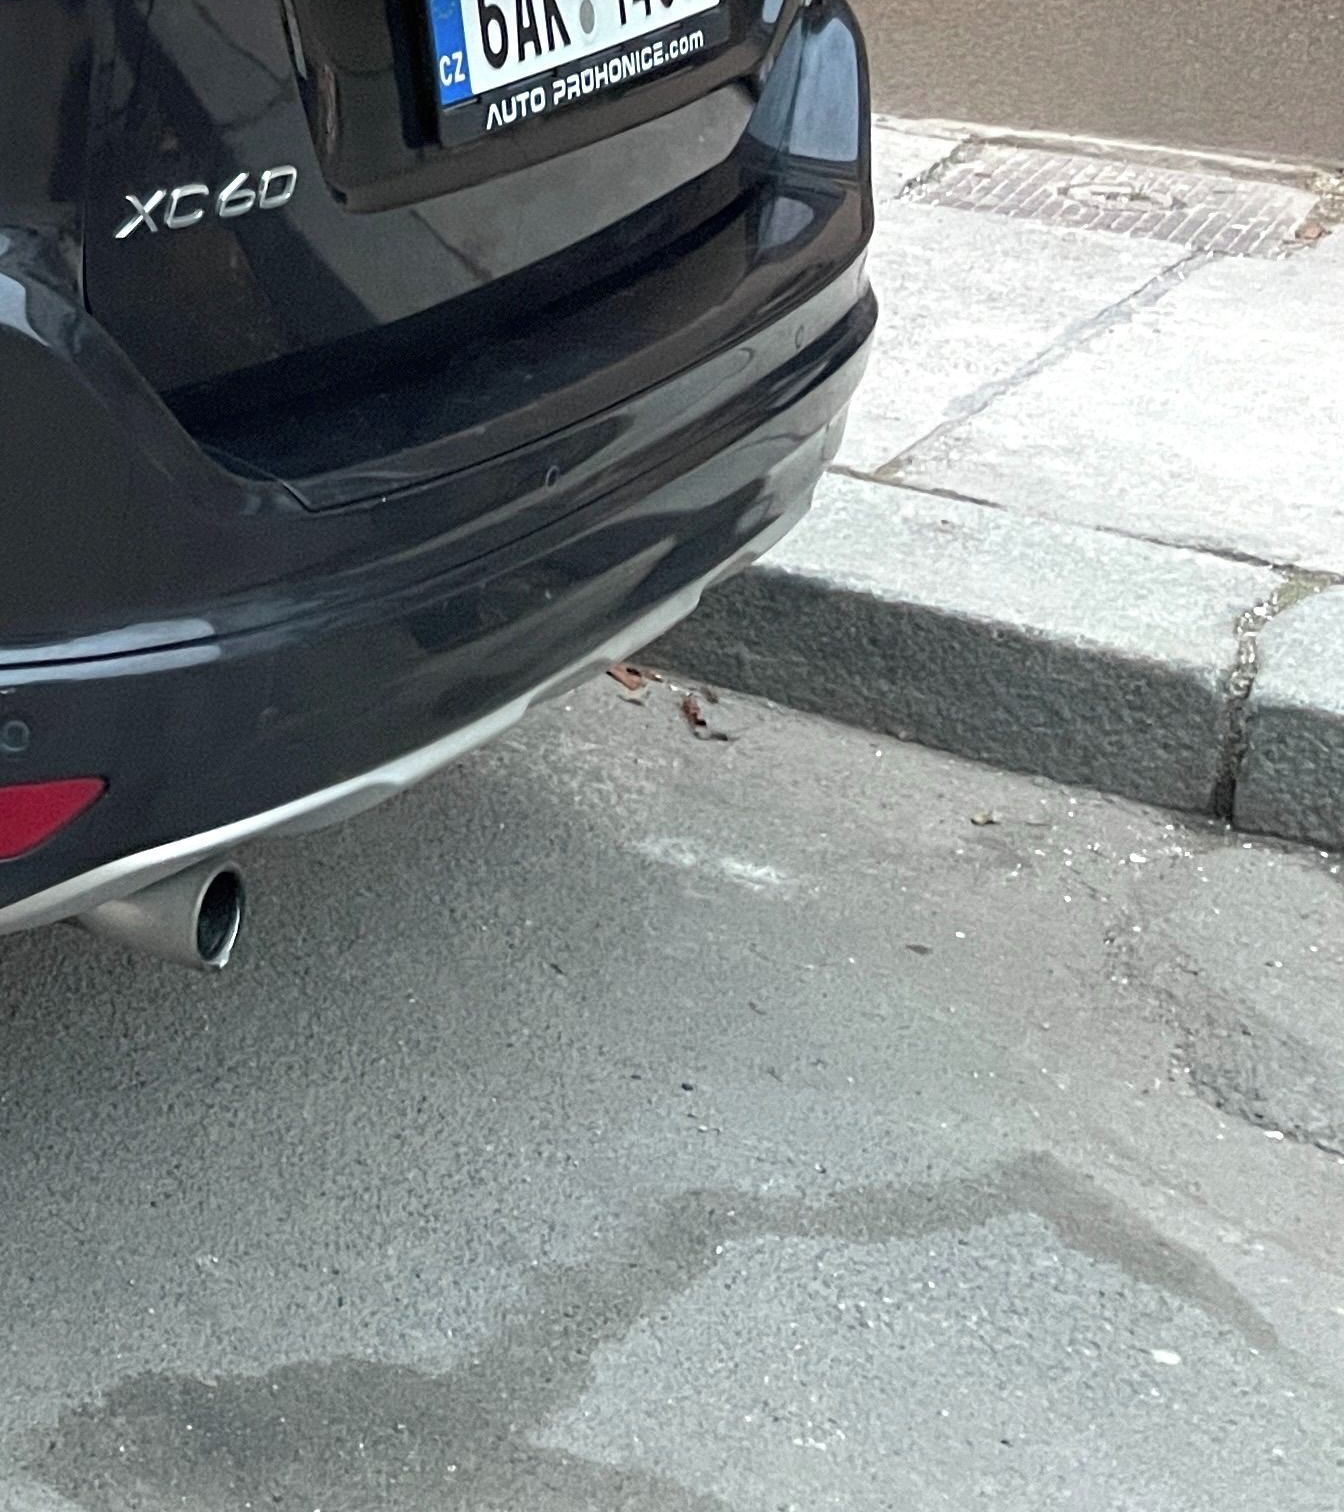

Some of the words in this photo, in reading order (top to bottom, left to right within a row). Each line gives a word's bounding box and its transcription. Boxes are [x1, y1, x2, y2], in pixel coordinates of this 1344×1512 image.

[439, 51, 466, 87] CZ
[486, 88, 546, 130] AUTO
[115, 165, 298, 239] XC60
